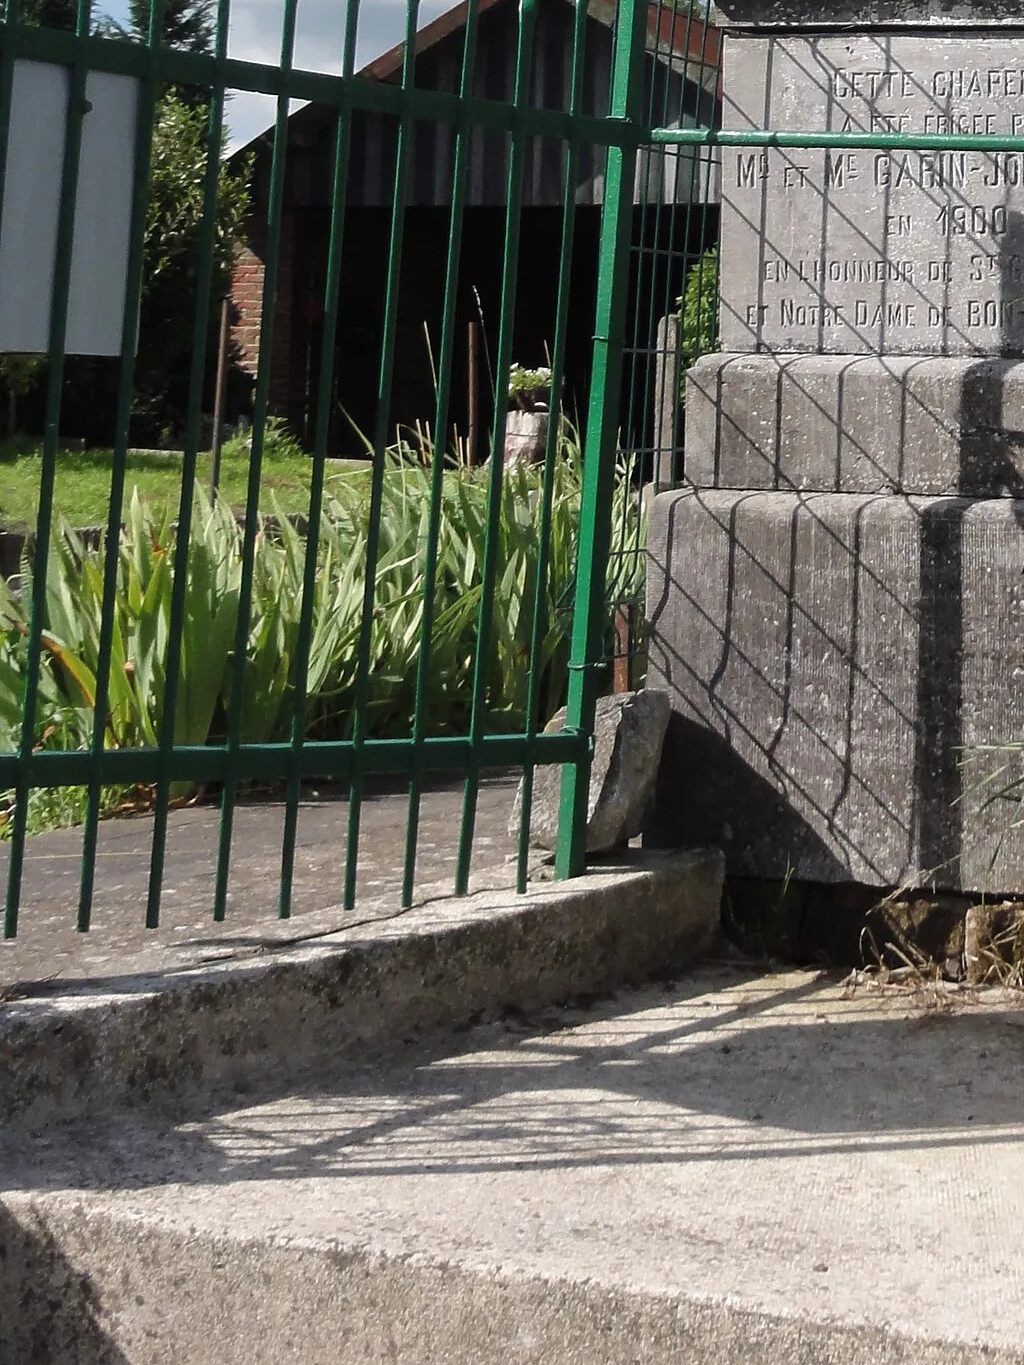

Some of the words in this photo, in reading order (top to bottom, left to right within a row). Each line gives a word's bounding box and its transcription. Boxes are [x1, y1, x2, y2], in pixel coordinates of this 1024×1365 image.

[834, 68, 916, 99] CETTE
[842, 113, 853, 133] A
[885, 214, 913, 237] EN
[936, 204, 1008, 236] 1900
[764, 259, 789, 283] EN
[928, 260, 952, 283] DE
[747, 303, 769, 328] ET
[781, 298, 844, 328] NOTRE
[855, 298, 916, 328] DAME
[928, 303, 952, 328] DE
